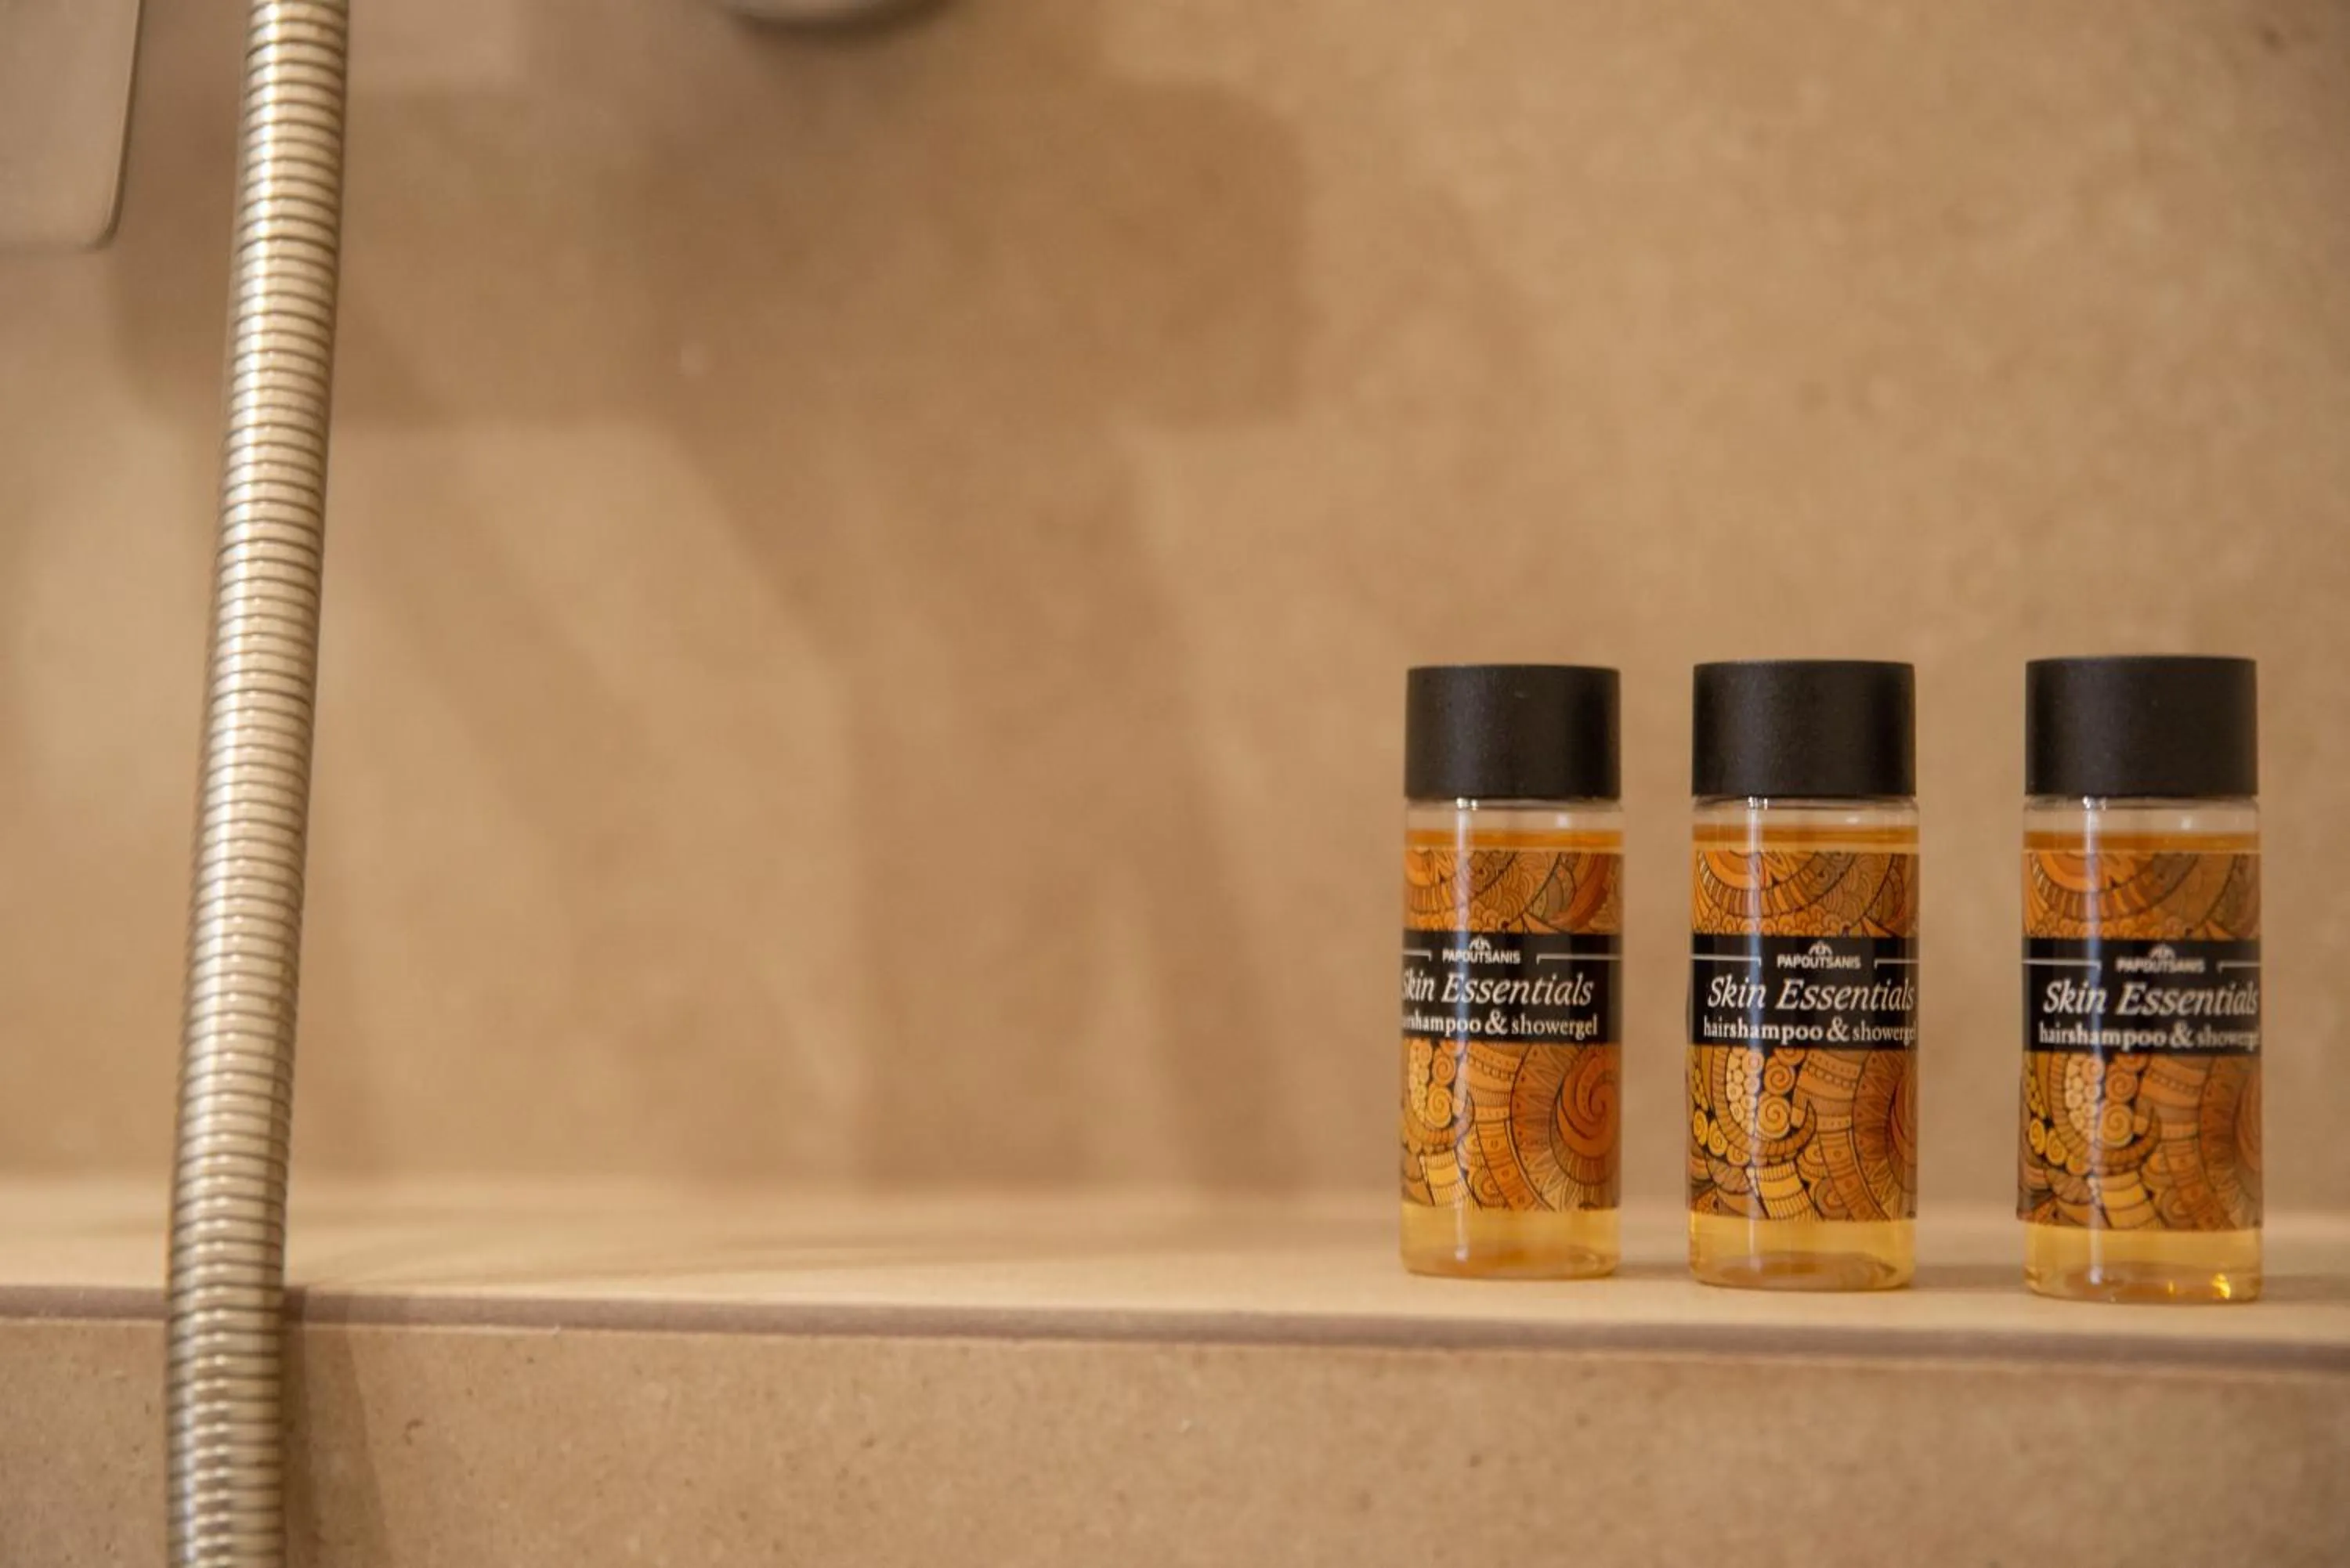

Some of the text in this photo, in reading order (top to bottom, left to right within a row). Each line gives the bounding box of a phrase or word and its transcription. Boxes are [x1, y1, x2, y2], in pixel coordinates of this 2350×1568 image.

[1442, 948, 1520, 964] PAPOUTSANIS
[1777, 954, 1861, 970] PAPOUTSANIS
[1441, 972, 1594, 1006] Essentials
[1707, 974, 1915, 1011] Skin Essentials
[2043, 977, 2258, 1016] Skin Essentials
[1484, 1010, 1509, 1035] &
[1511, 1013, 1598, 1040] showergel
[1704, 1015, 1823, 1046] hairshampoo
[1826, 1016, 1849, 1042] &
[2039, 1021, 2167, 1051] hairshampoo
[2169, 1021, 2194, 1048] &
